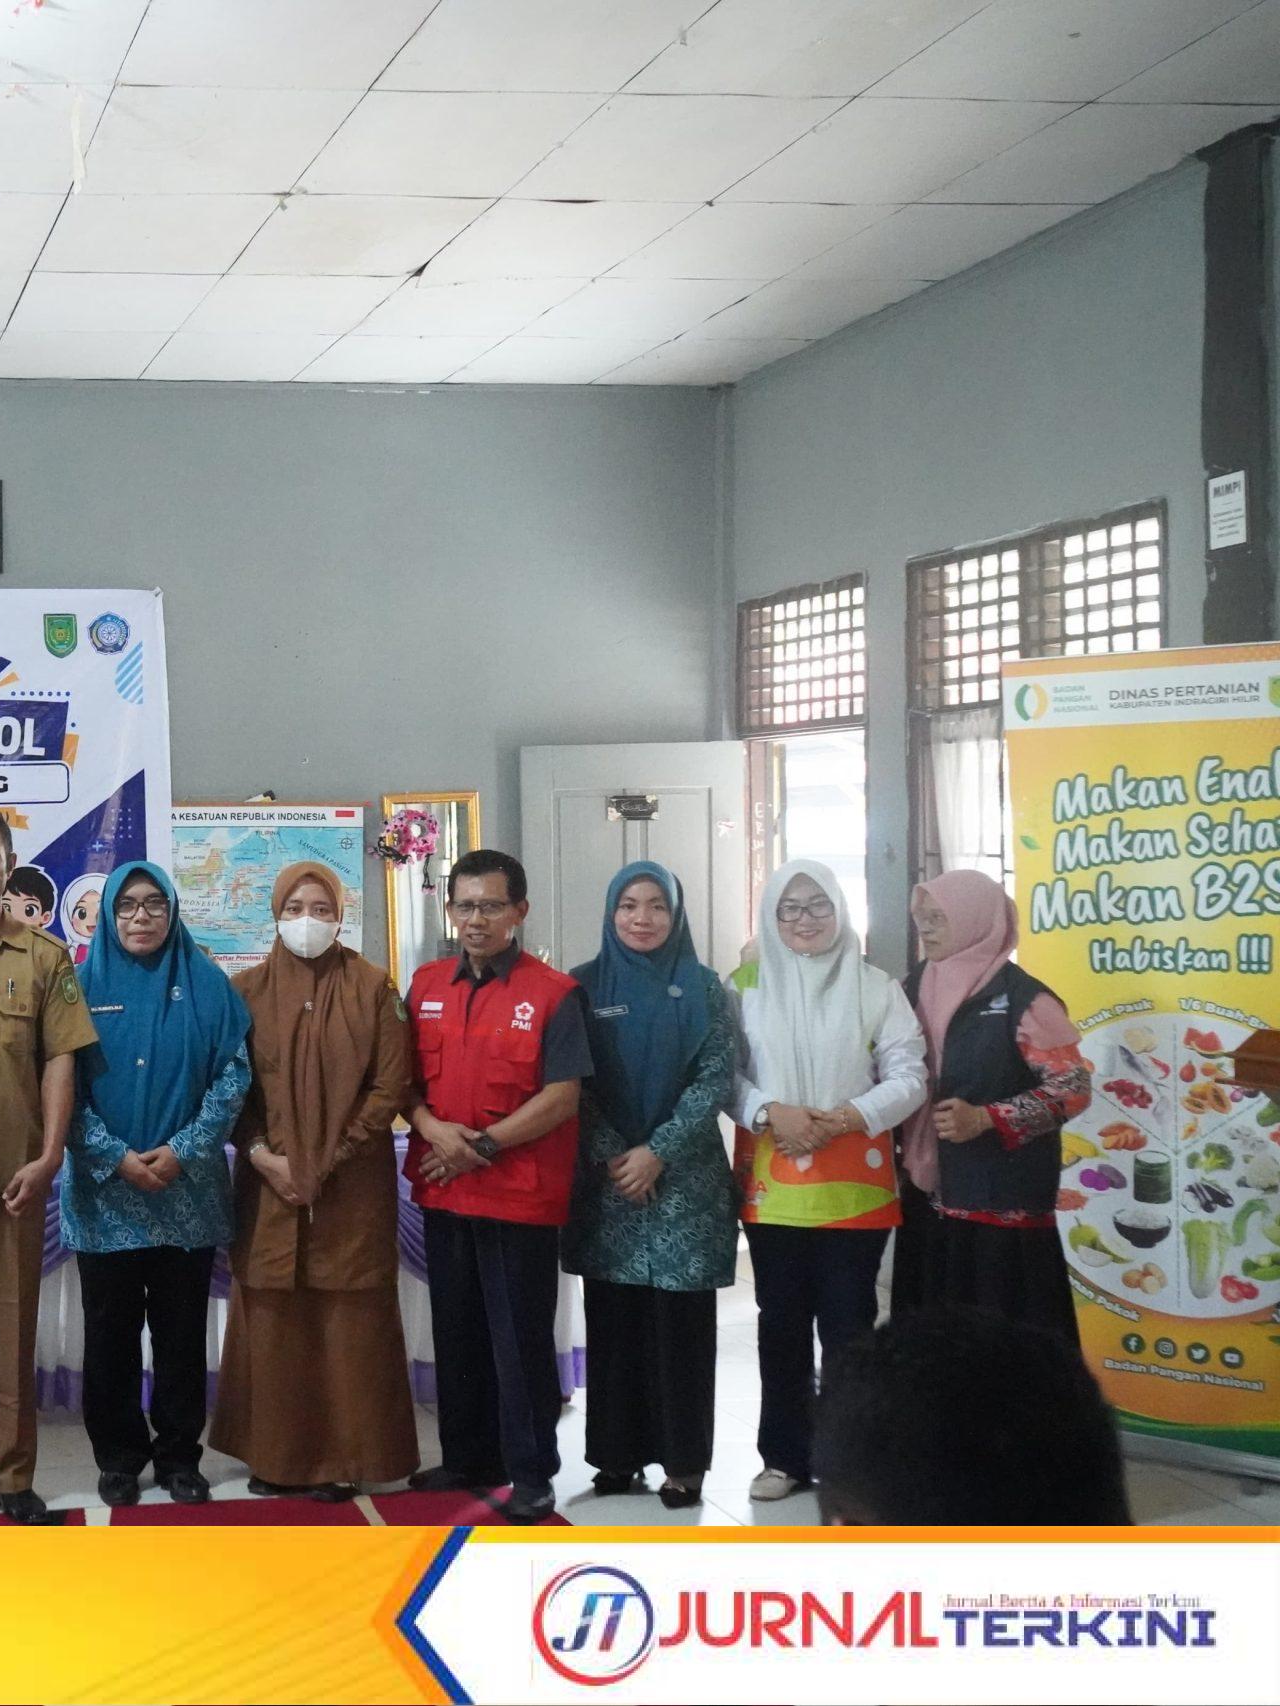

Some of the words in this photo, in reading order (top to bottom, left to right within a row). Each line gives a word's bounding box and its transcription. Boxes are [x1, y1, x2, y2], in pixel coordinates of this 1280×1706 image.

[1109, 687, 1160, 701] DINAS
[1164, 682, 1261, 698] PERTANIAN
[1109, 700, 1171, 710] KABUPATEN
[1173, 697, 1229, 707] INDRAGIRI
[1232, 695, 1261, 704] HILIR
[1054, 766, 1187, 823] Makan
[179, 812, 228, 821] KESATUAN
[230, 812, 276, 821] REPUBLIK
[277, 812, 327, 821] INDONESIA
[1054, 817, 1179, 874] Makan
[1187, 808, 1280, 858] Seha
[1031, 872, 1185, 934] Makan
[1191, 861, 1280, 922] B2S
[1089, 936, 1230, 975] Habiskan
[1236, 934, 1273, 974] !!!
[1077, 1008, 1113, 1031] Lauk
[1114, 998, 1155, 1015] Pauk
[1178, 997, 1202, 1012] 1/6
[510, 1018, 532, 1032] PMI
[1103, 1357, 1147, 1373] Badan
[1149, 1364, 1202, 1383] Pangan
[1203, 1373, 1265, 1393] Nasional
